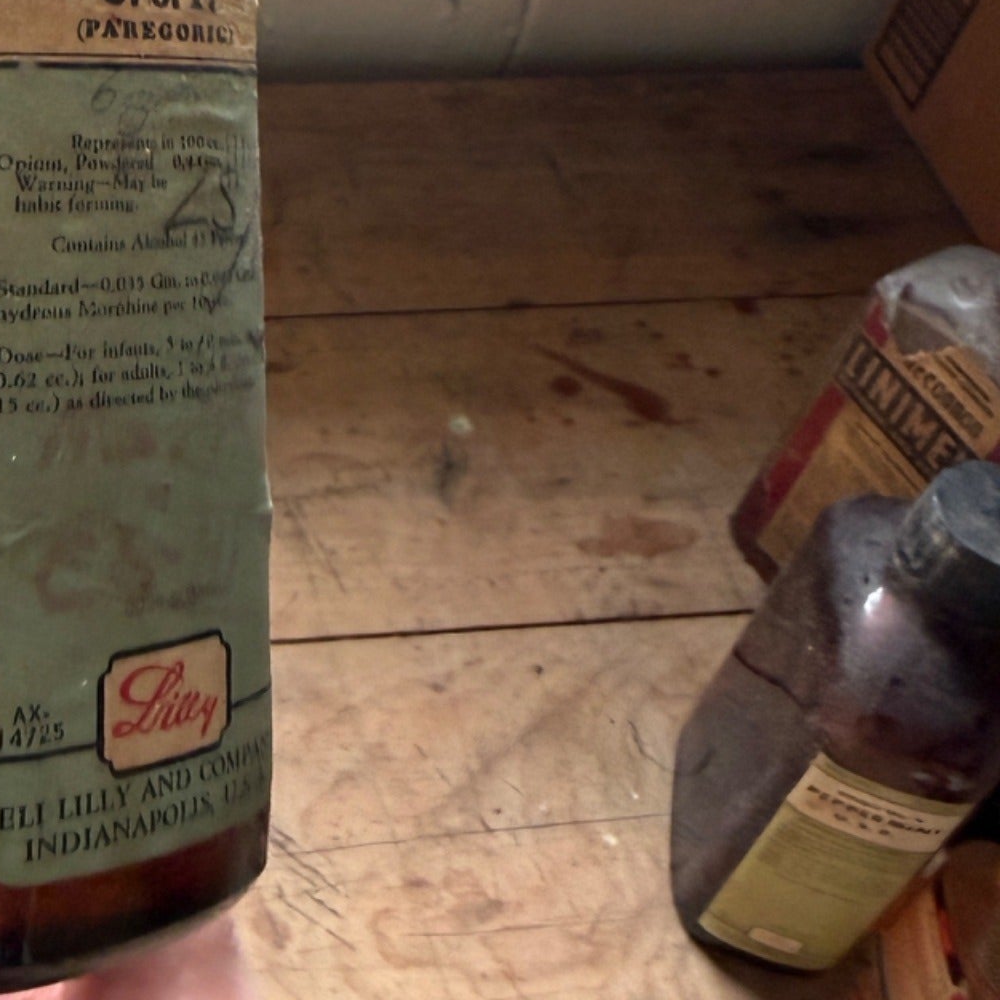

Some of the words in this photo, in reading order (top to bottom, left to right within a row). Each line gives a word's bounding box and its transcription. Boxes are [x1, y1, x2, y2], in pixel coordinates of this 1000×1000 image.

[76, 17, 234, 45] (PAREGORIC)
[150, 173, 168, 190] be
[51, 234, 127, 253] Contains
[78, 297, 159, 320] Morphine
[91, 364, 117, 385] for
[112, 661, 219, 740] Lilly
[0, 800, 46, 832] ELI
[58, 782, 132, 821] LILLY
[140, 767, 192, 803] AND
